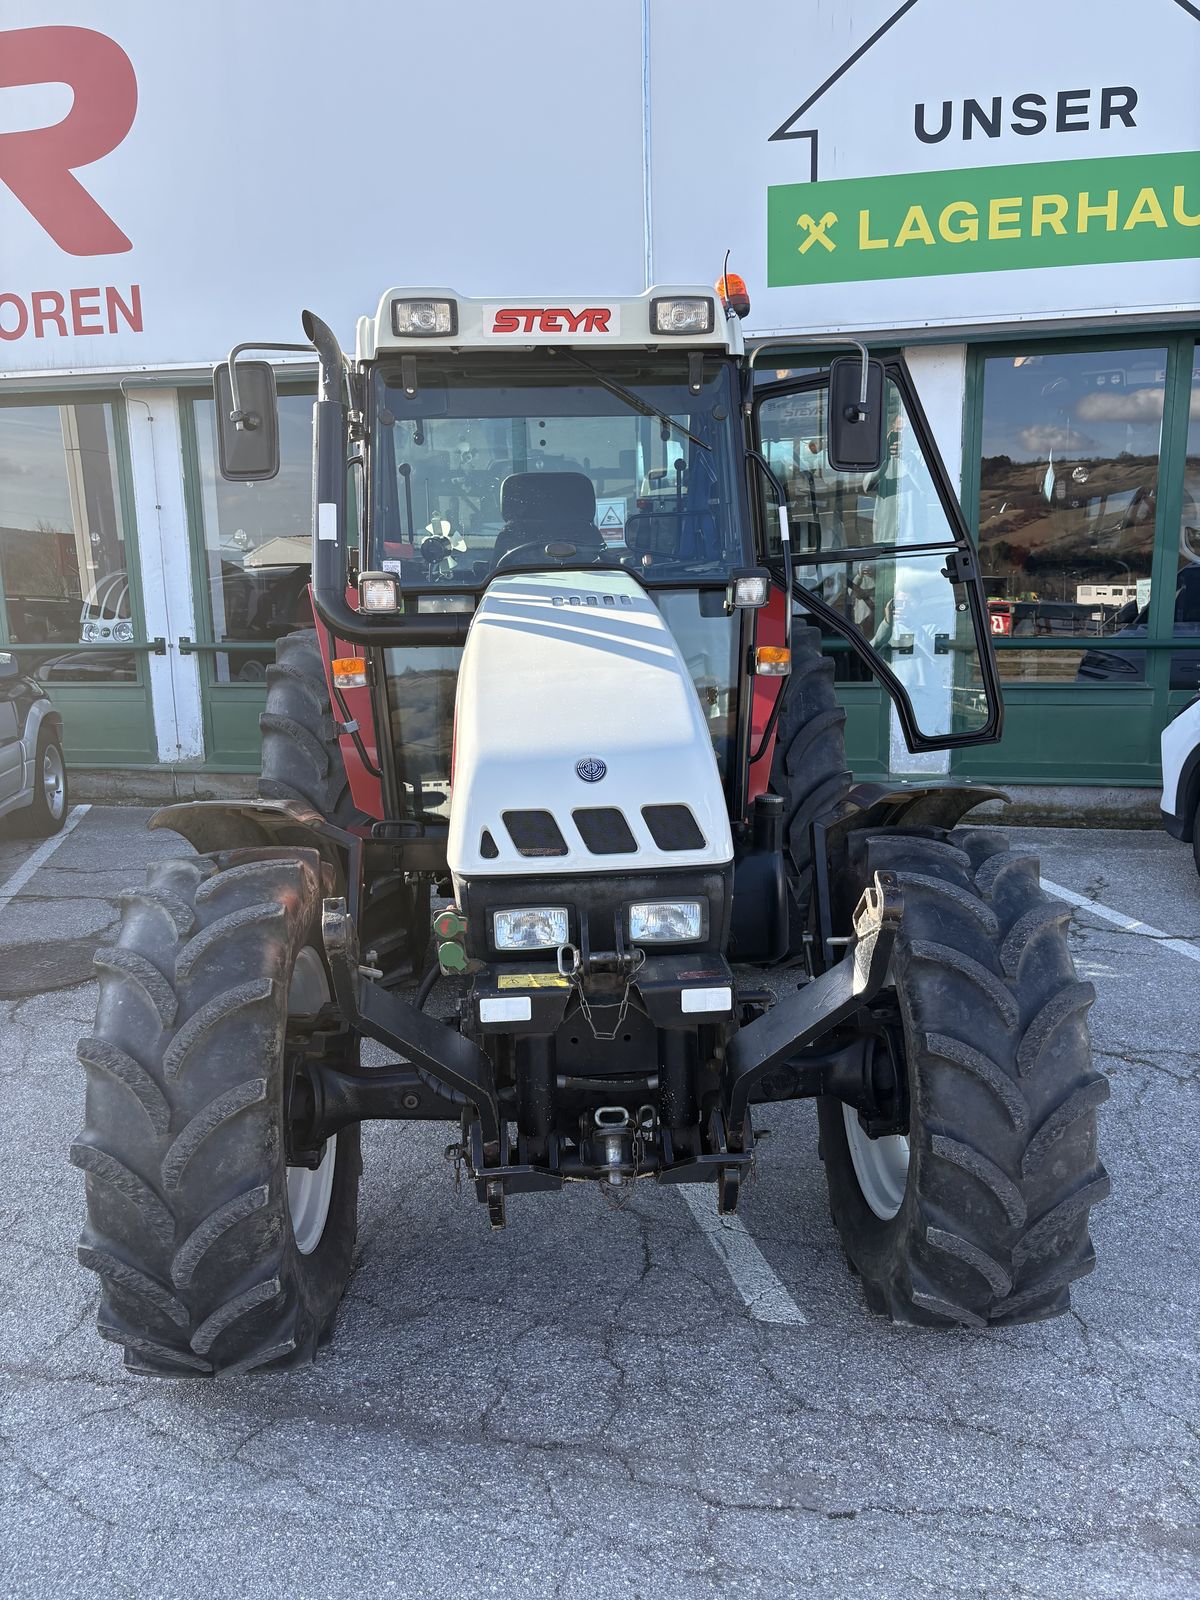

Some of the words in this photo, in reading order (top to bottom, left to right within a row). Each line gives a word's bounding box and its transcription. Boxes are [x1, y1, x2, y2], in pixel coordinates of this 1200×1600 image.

[914, 86, 1138, 144] UNSER
[858, 185, 1200, 250] LAGERHAU
[0, 284, 143, 341] OREN
[491, 308, 612, 334] STEYR
